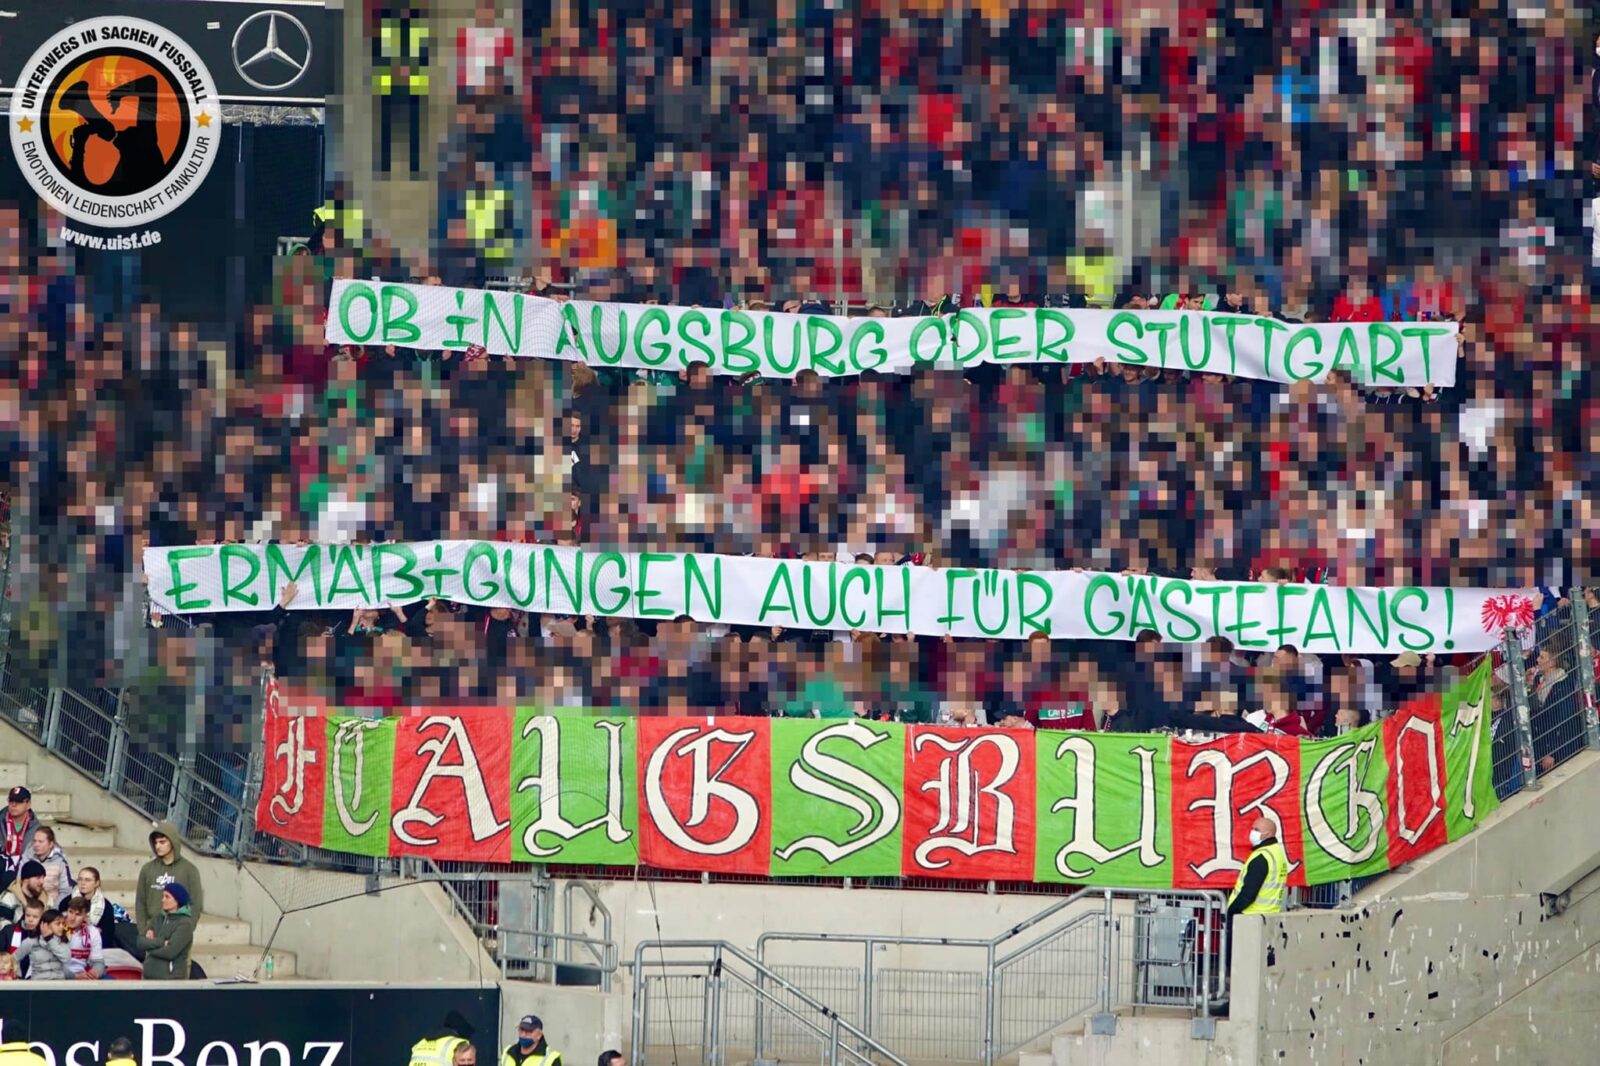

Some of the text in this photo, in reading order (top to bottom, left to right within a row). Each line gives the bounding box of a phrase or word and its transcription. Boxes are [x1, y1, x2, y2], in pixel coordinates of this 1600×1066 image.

[338, 282, 422, 343] OB
[556, 302, 888, 375] AUGSBURG
[909, 307, 1077, 363] ODER
[1106, 311, 1451, 383] STUTTGART
[758, 561, 911, 630] AUCH
[936, 568, 1053, 636] FÜR
[1083, 574, 1455, 651] GÄSTEFANS!
[391, 713, 1386, 881] AUGSBURG
